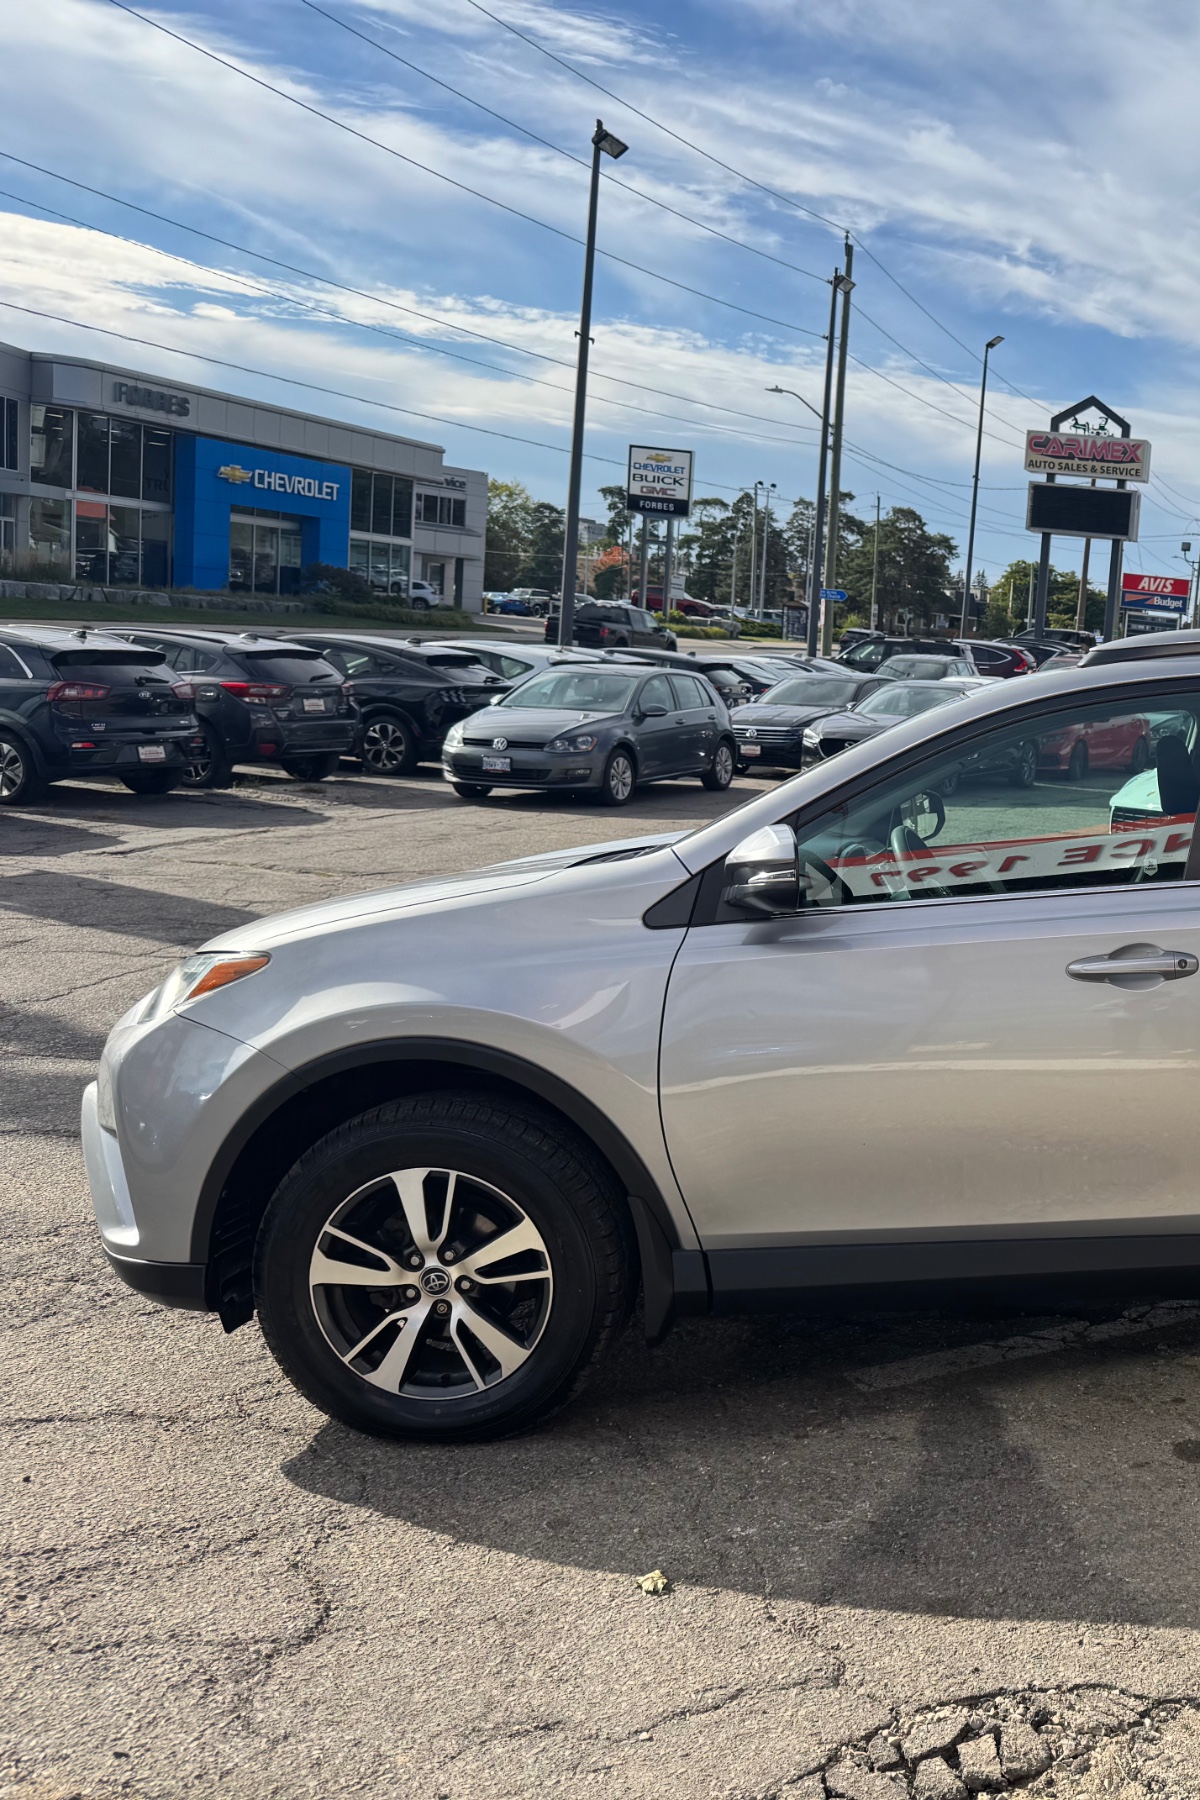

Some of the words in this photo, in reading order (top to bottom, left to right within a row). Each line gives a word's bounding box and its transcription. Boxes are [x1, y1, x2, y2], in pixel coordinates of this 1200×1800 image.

[113, 381, 191, 417] FORBES
[1028, 435, 1144, 463] CARIMEX
[633, 462, 686, 475] CHEVROLET
[1028, 459, 1056, 470] AUTO
[1057, 462, 1088, 473] SALES
[1090, 464, 1098, 474] &
[1099, 465, 1141, 477] SERVICE
[254, 469, 340, 501] CHEVROLET
[444, 477, 467, 489] vice
[632, 473, 685, 487] BUICK
[640, 485, 677, 497] GMC
[640, 500, 675, 511] FORBES
[1138, 577, 1174, 593] AVIS
[1154, 596, 1183, 609] Budget
